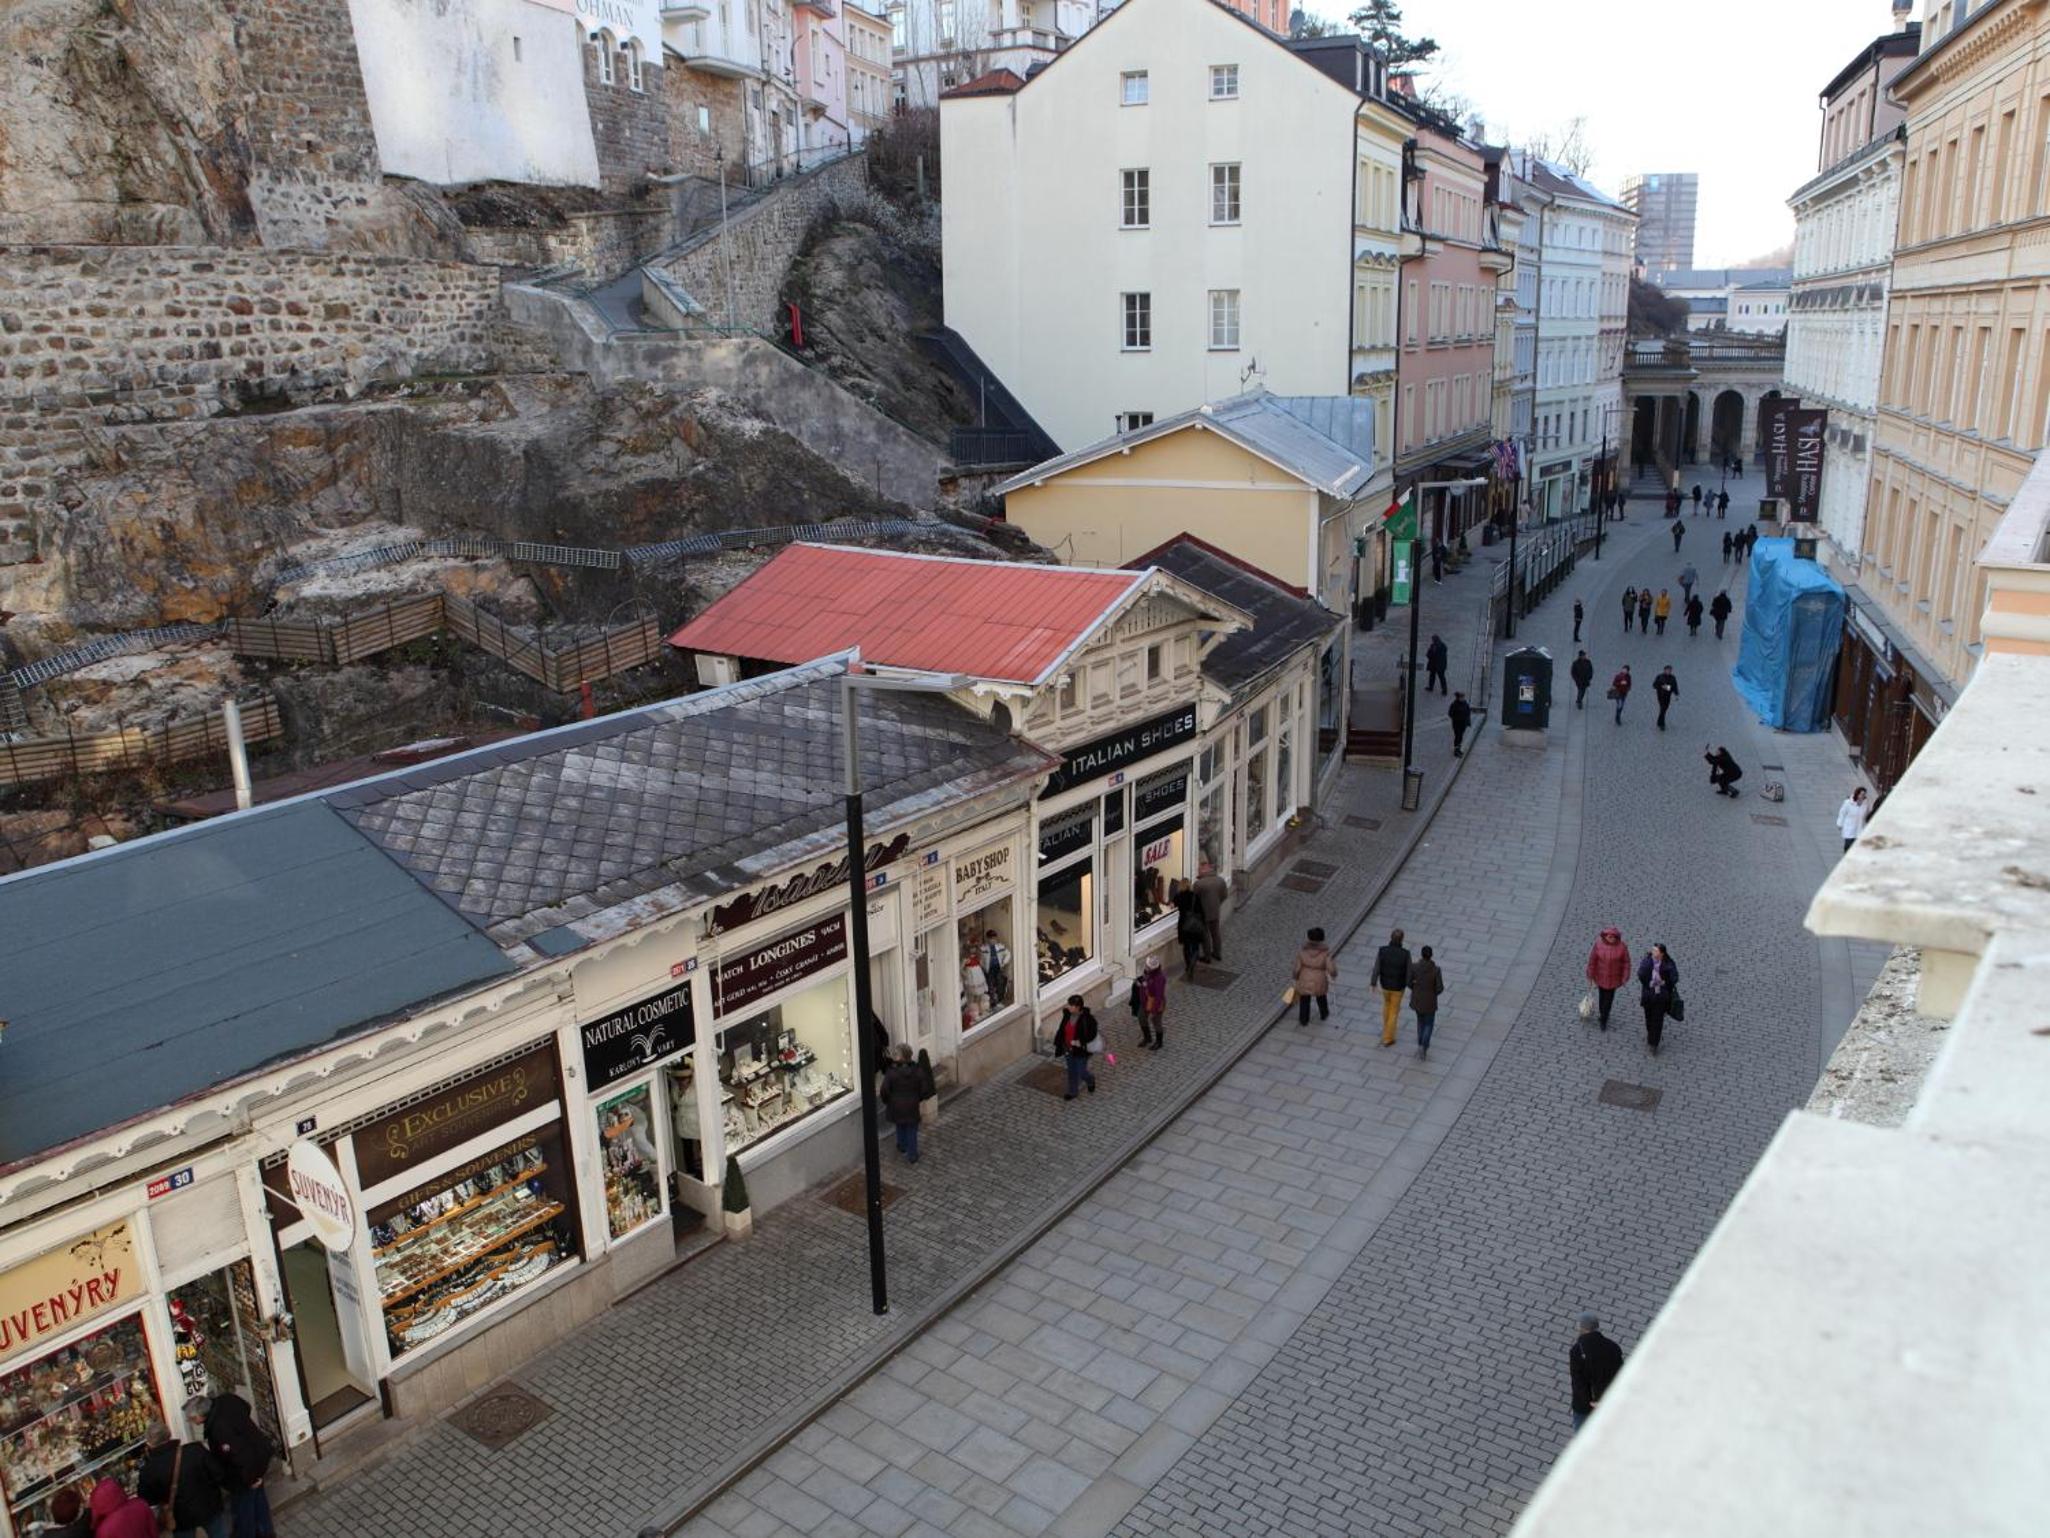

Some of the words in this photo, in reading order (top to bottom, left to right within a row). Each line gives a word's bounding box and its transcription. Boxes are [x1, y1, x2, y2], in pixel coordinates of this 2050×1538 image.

[1771, 423, 1787, 454] HASI
[1795, 437, 1820, 472] HASI
[1072, 738, 1135, 775] ITALIAN
[1142, 714, 1193, 748] SHOES
[1145, 778, 1185, 803] SHOES
[955, 857, 983, 885] BABY
[983, 847, 1010, 871] SHOP
[1144, 838, 1171, 866] SALE
[975, 882, 992, 896] ITALY
[749, 930, 817, 971] LONGINES
[585, 1012, 638, 1048] NATURAL
[637, 988, 690, 1025] COSMETIC
[403, 1074, 513, 1138] EXCLUSIVE
[174, 1171, 190, 1187] 30
[291, 1168, 352, 1226] SUVENÝR
